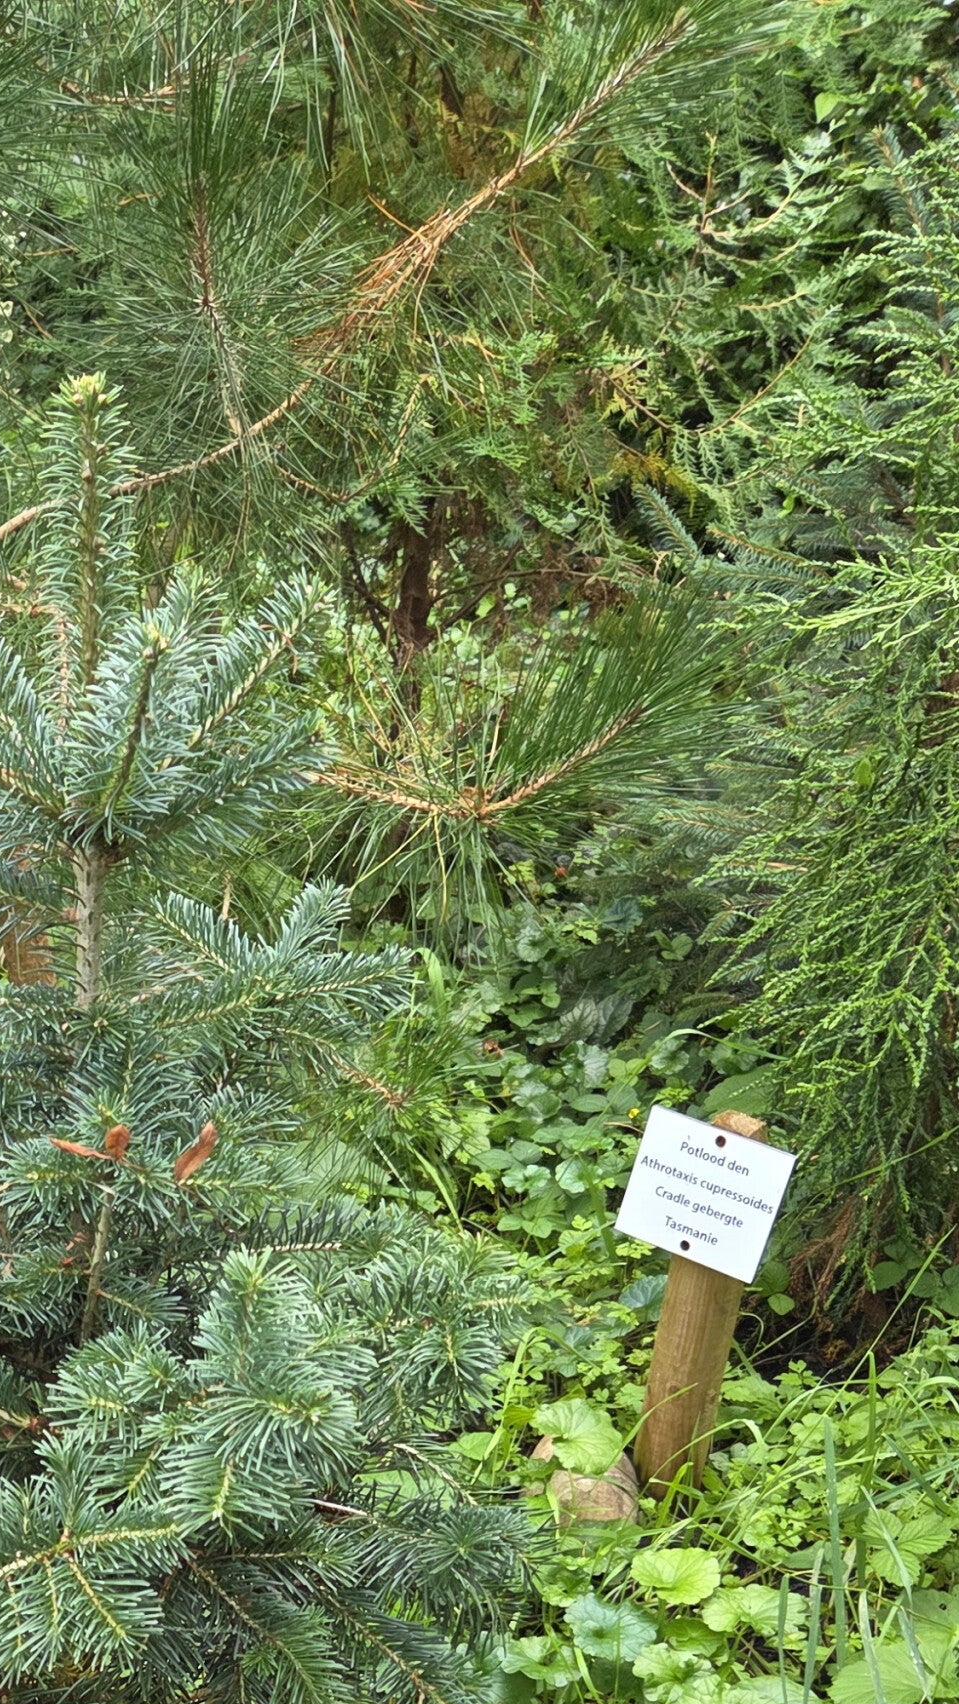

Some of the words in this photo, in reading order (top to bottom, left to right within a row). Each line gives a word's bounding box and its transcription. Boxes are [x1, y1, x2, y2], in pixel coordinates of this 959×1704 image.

[679, 1141, 726, 1167] Potlood
[727, 1160, 750, 1177] den
[640, 1155, 698, 1185] Athrotaxis
[700, 1179, 774, 1215] cupressoides
[655, 1186, 691, 1207] Cradle
[691, 1201, 744, 1228] gebergte
[665, 1215, 719, 1246] Tasmanie
